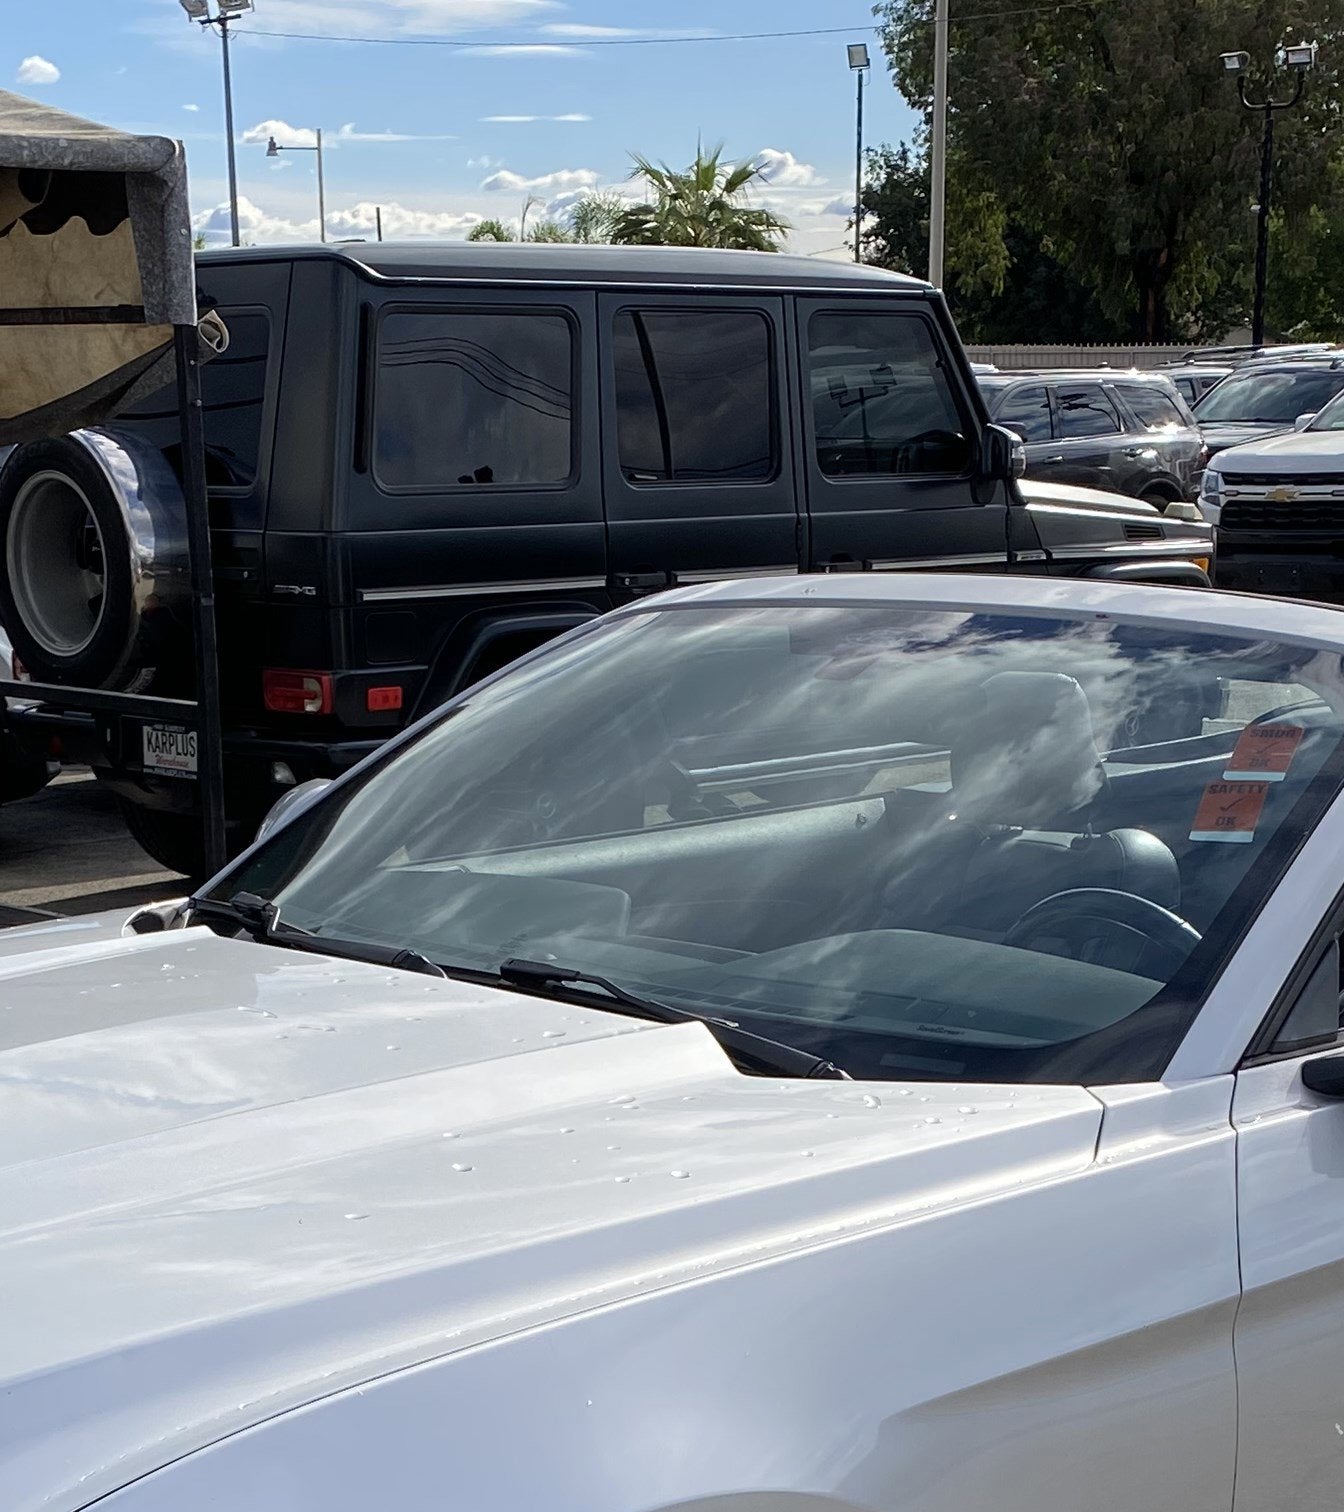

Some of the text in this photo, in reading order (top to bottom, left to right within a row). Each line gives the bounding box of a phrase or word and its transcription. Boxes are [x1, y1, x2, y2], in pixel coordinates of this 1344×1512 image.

[147, 731, 196, 757] KARPLUS
[1208, 784, 1267, 794] SAFETY
[1215, 816, 1238, 827] OK
